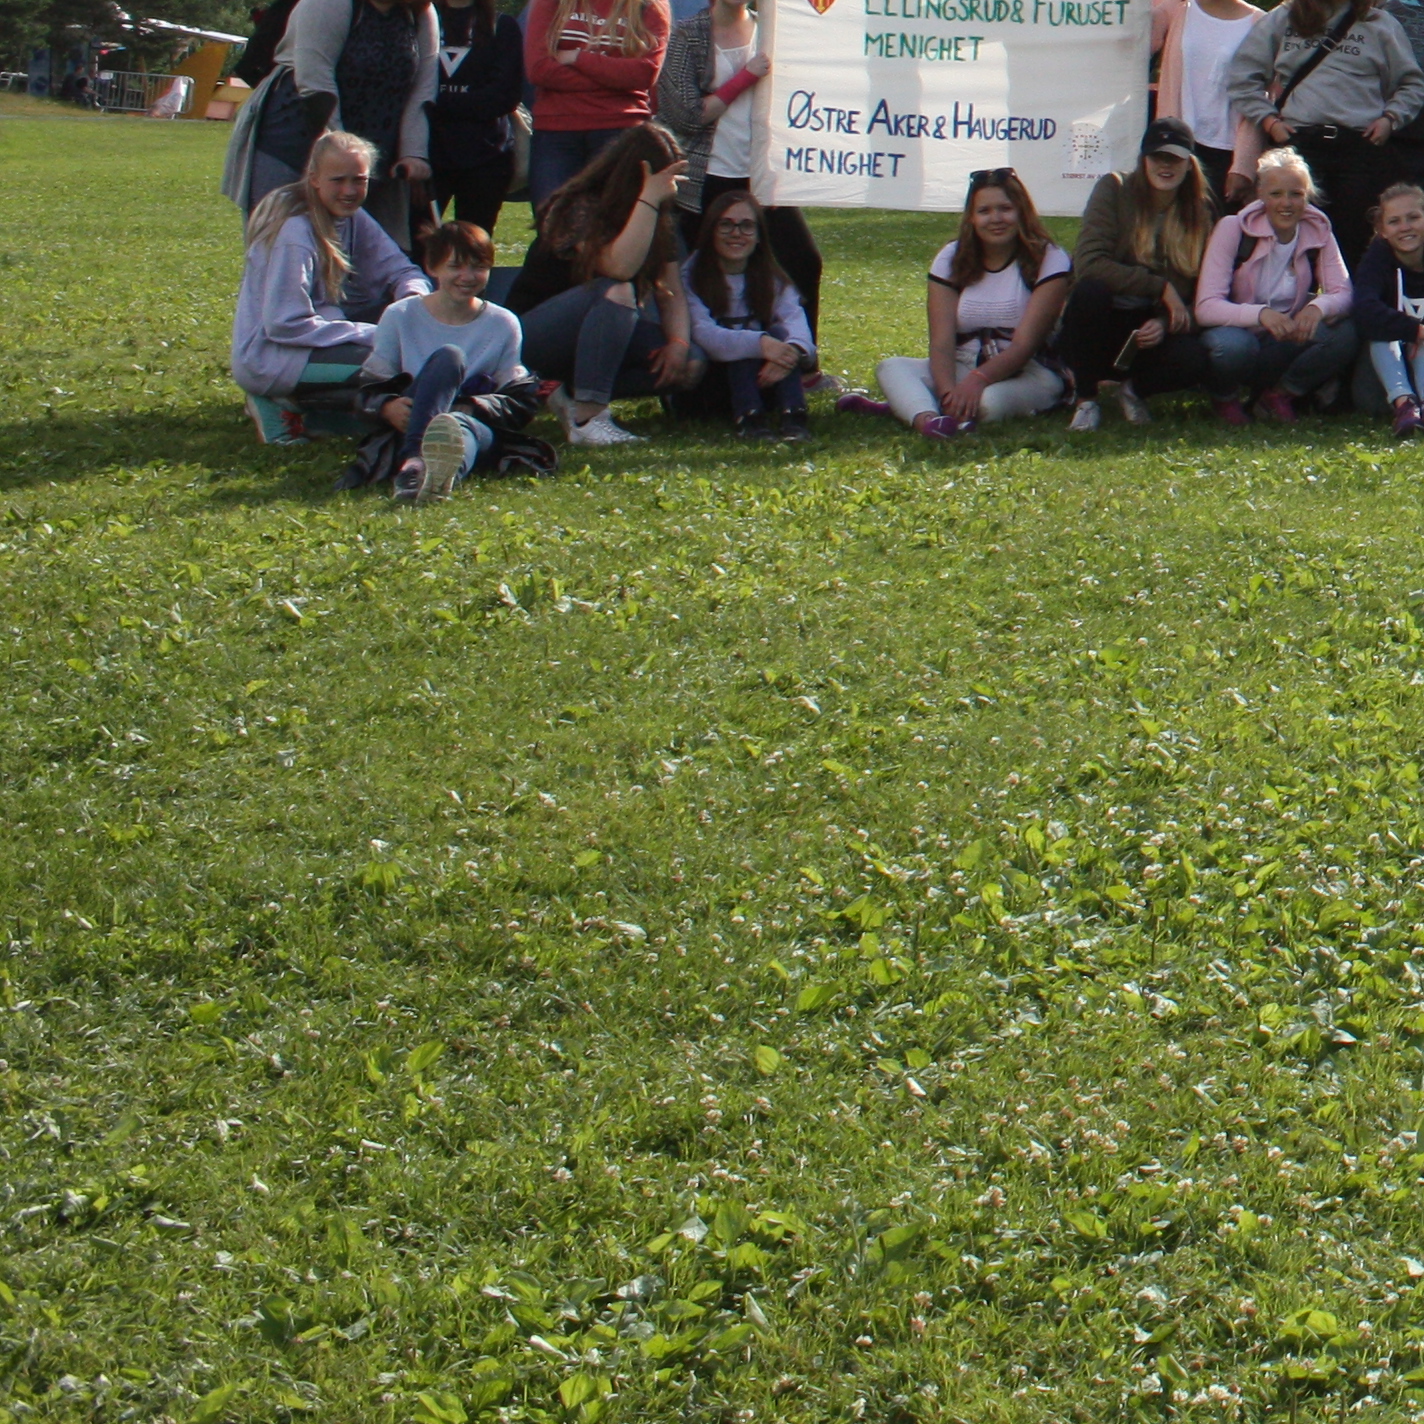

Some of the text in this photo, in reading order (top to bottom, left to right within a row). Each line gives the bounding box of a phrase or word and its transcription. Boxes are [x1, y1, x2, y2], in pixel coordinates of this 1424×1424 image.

[864, 33, 984, 62] MENIGHET
[787, 90, 861, 134] ØSTRE
[867, 98, 930, 138] AKER
[953, 101, 1056, 141] HAUGERUD
[786, 147, 906, 177] MENIGHET
